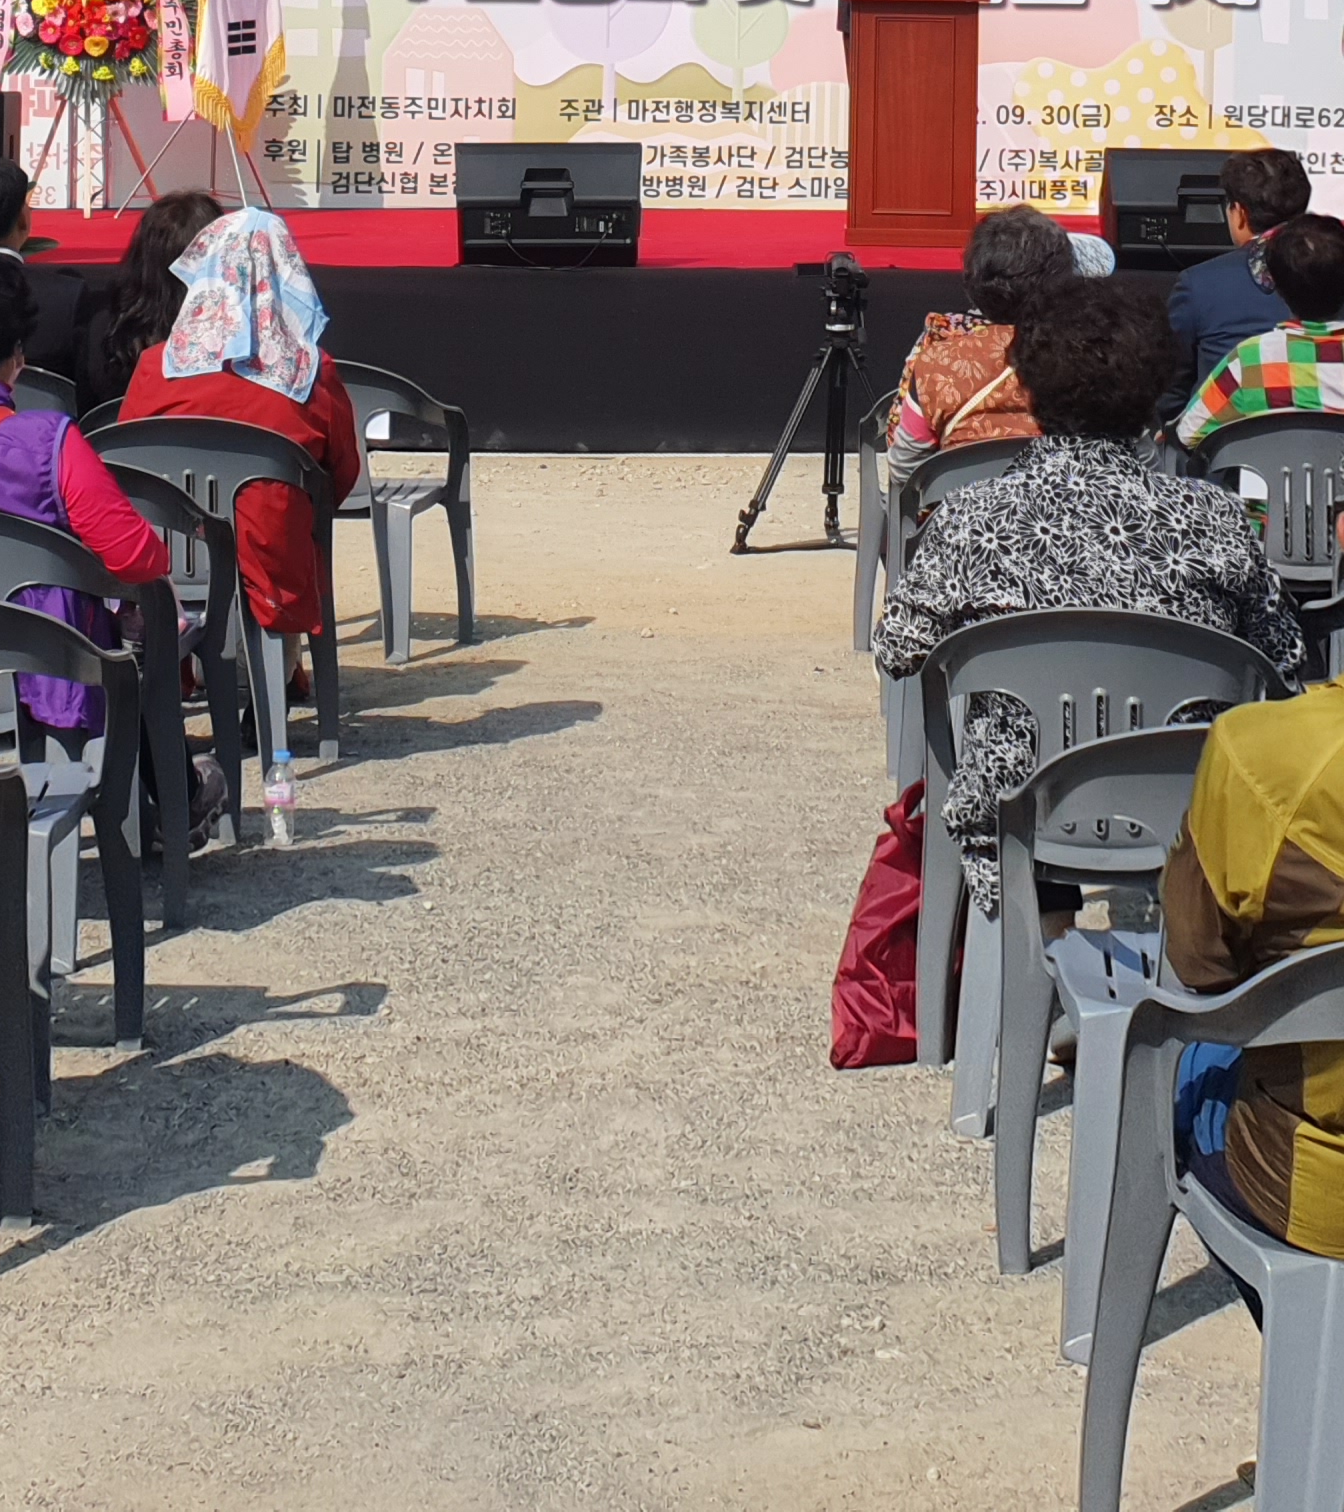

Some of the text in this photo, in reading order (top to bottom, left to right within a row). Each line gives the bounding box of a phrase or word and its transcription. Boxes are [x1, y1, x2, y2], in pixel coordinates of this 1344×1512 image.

[264, 94, 308, 119] 주최
[332, 96, 517, 121] 마전동주민자치회
[558, 98, 605, 122] 주관
[627, 99, 811, 124] 마전행정복지센터
[996, 104, 1032, 125] 09.
[1041, 103, 1111, 129] 30(금)
[1154, 105, 1201, 128] 장소
[263, 139, 308, 163] 후원
[332, 141, 353, 164] 탑
[361, 141, 405, 165] 병원
[645, 145, 758, 169] 가족봉사단
[784, 146, 850, 169] 검단농
[330, 171, 419, 195] 검단신협
[641, 175, 707, 199] 방병원
[735, 176, 779, 200] 검단
[976, 179, 1089, 201] 주)시대풍력
